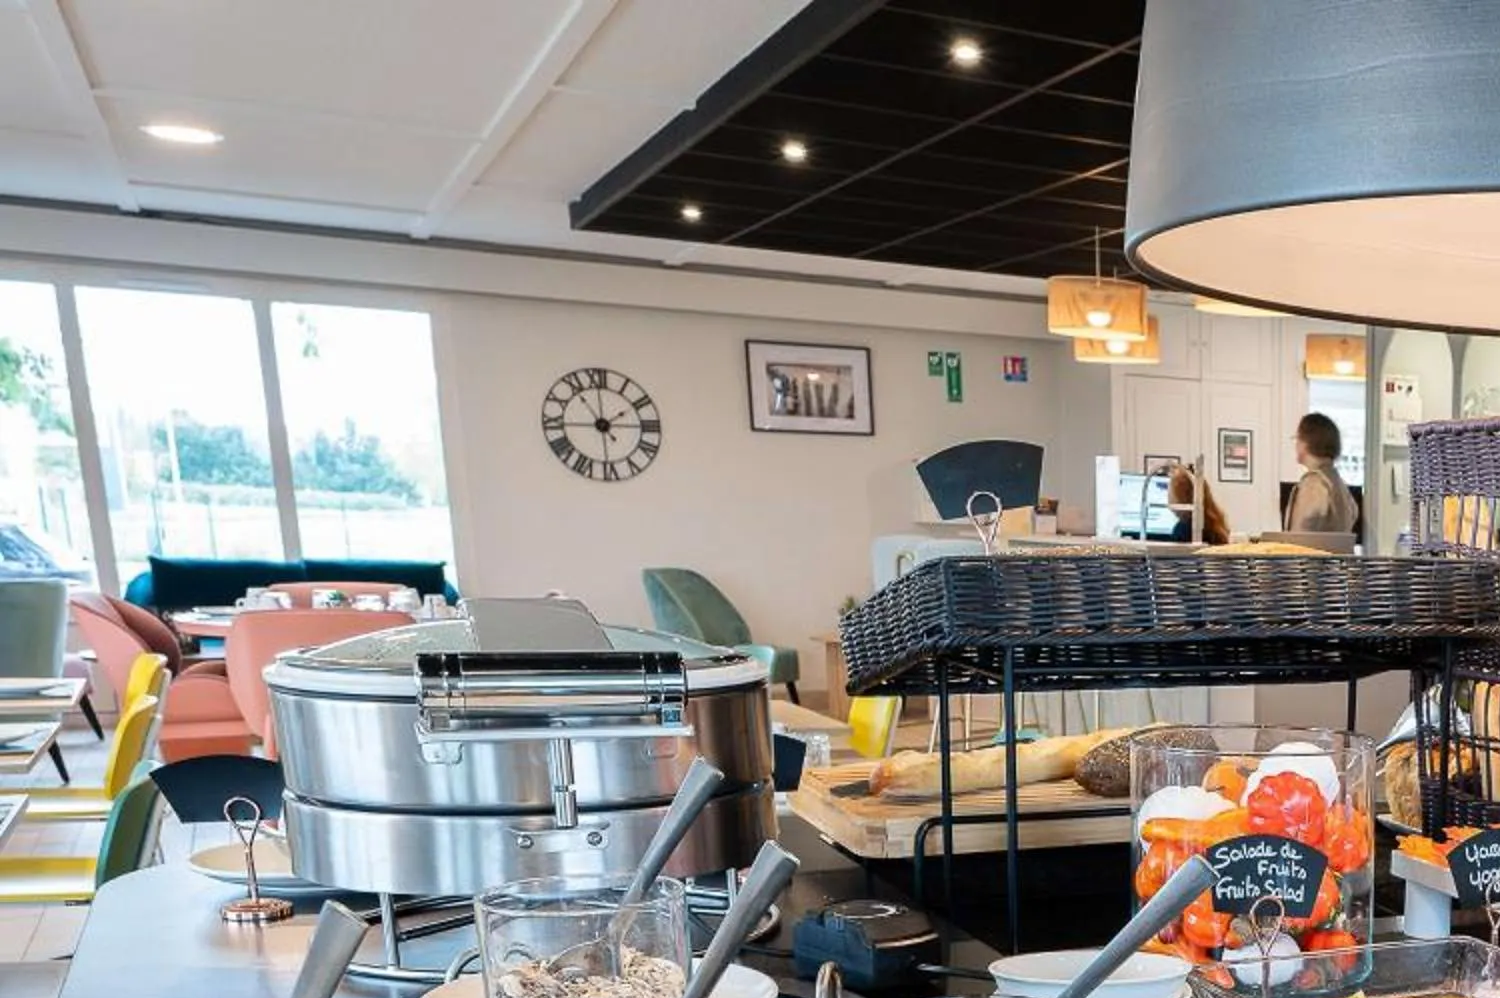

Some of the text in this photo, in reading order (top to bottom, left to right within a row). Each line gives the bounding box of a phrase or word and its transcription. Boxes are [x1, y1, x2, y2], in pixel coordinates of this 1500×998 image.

[1213, 841, 1303, 870] Salade de
[1256, 859, 1307, 880] Fruits
[1214, 876, 1306, 903] Fruits Salad
